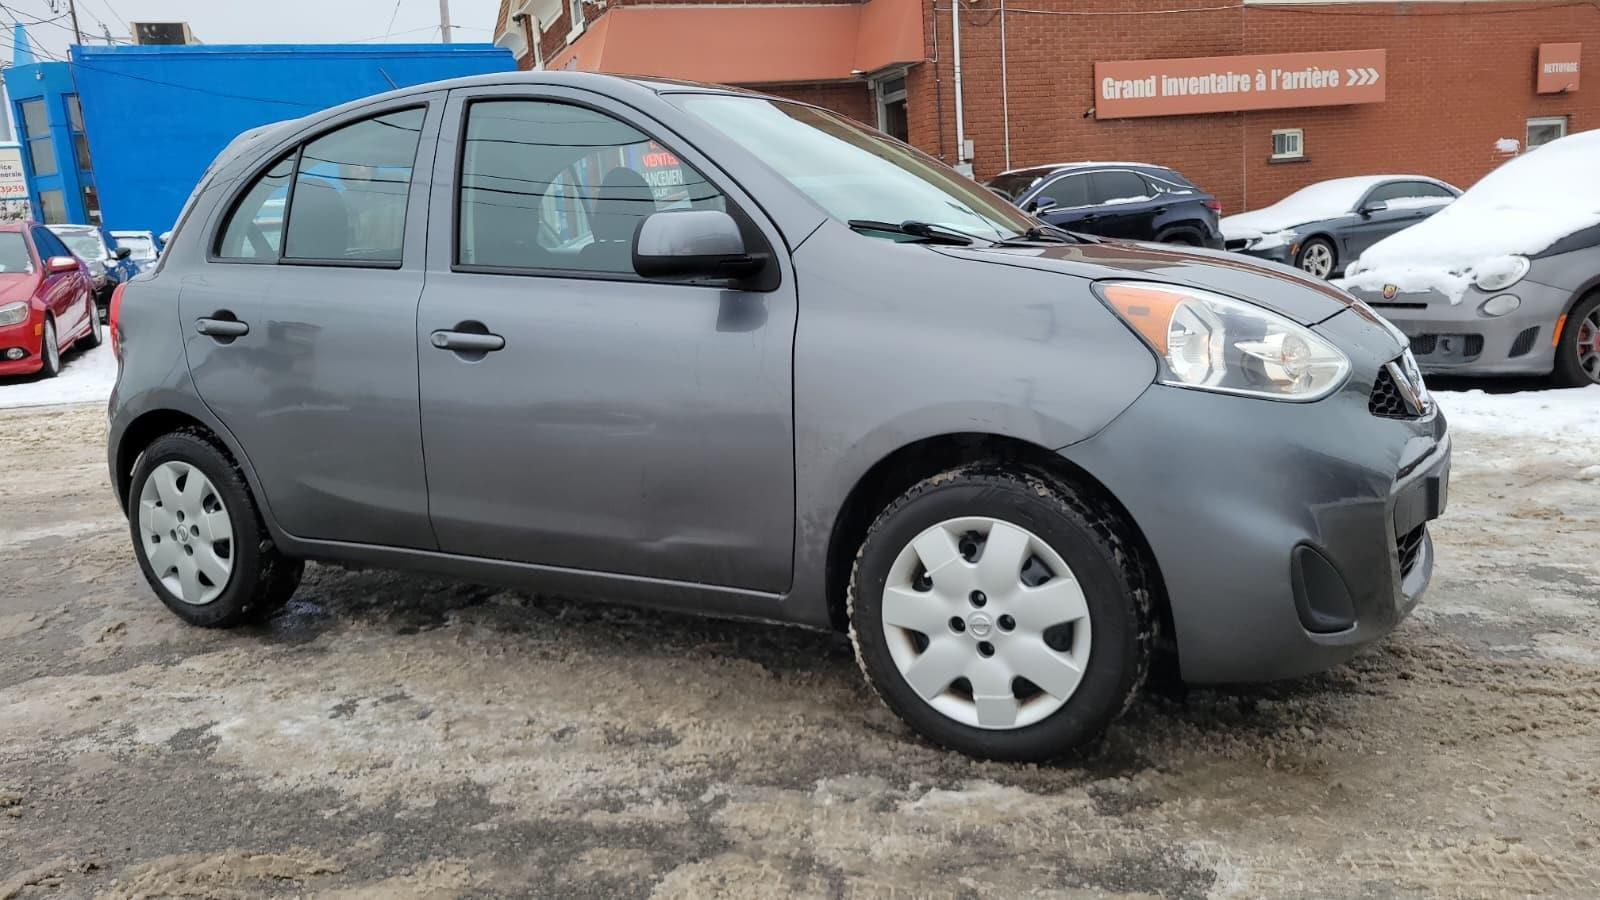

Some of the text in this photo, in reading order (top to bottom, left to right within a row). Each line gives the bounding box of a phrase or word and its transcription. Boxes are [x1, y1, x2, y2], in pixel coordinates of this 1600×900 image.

[1102, 66, 1339, 99] Grand inventaire à l'arrière
